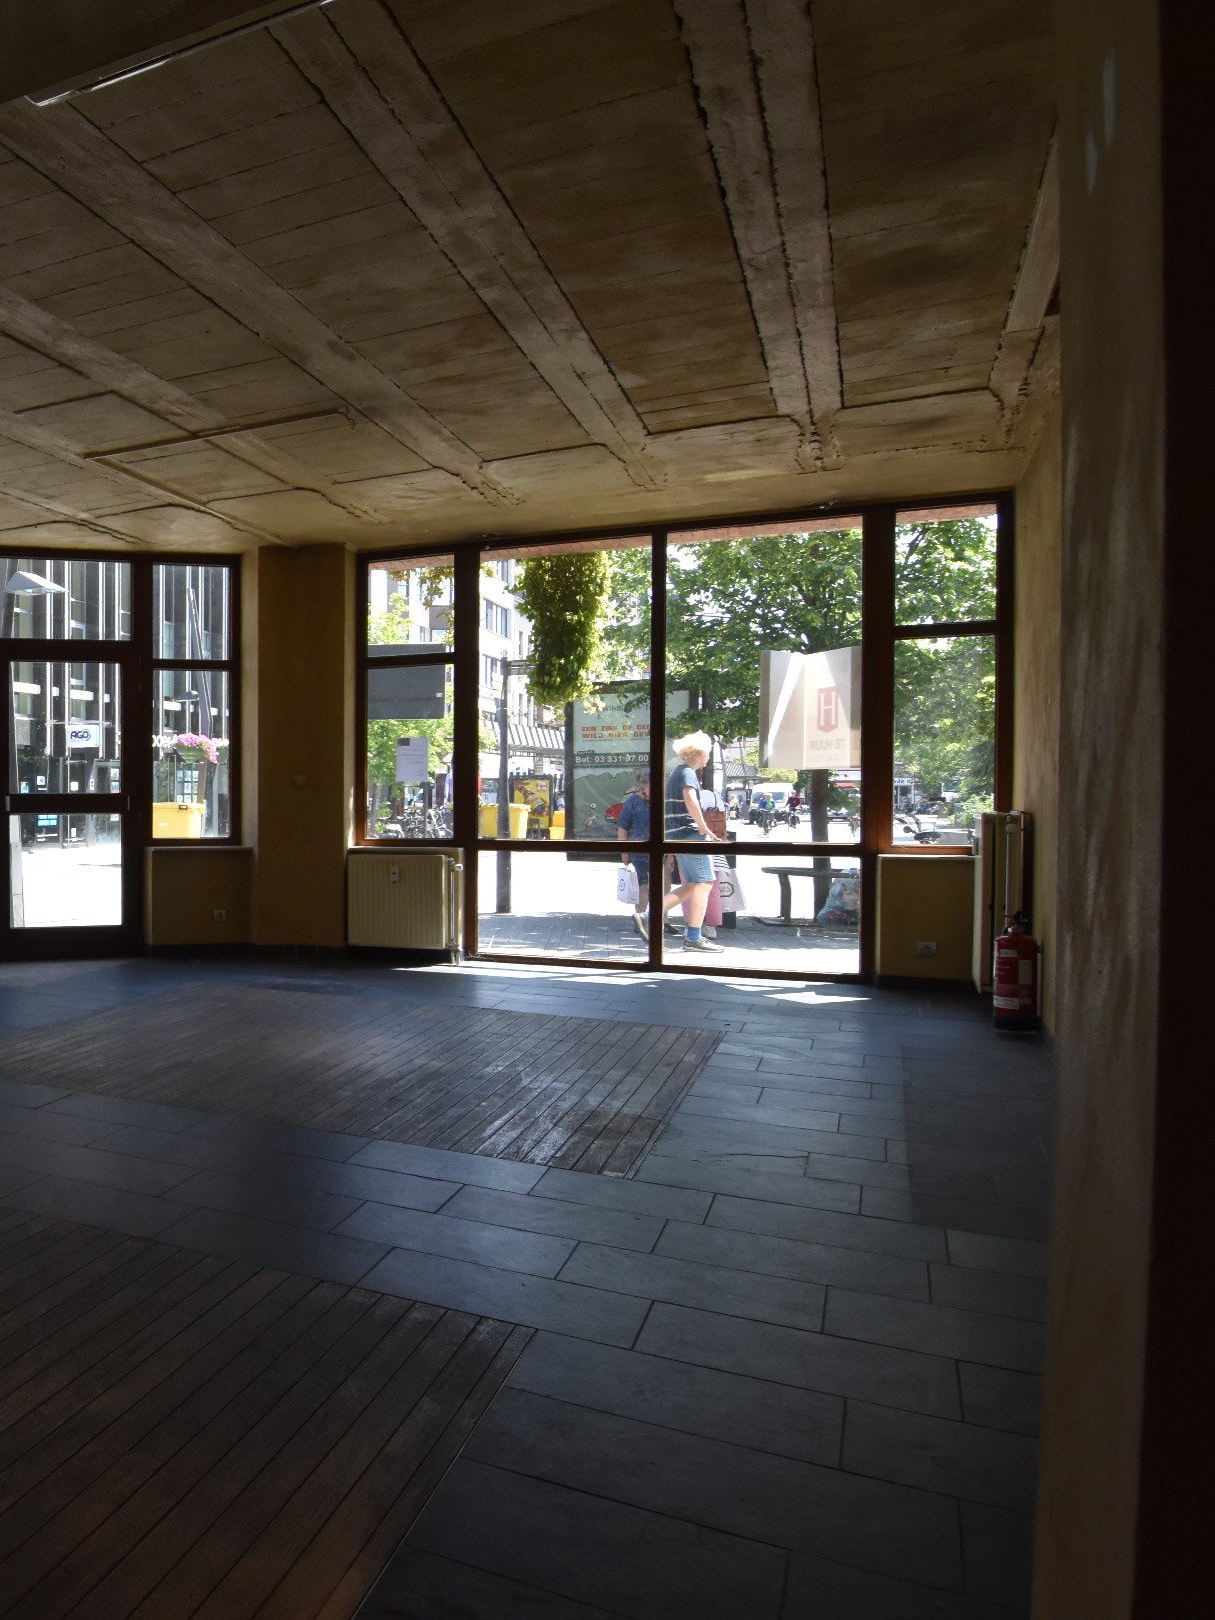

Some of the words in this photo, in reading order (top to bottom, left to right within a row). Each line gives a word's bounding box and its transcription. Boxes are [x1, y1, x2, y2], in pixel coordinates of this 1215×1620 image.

[70, 730, 90, 740] AGO
[575, 756, 591, 764] Bel:
[594, 755, 605, 763] 03
[607, 755, 622, 763] 331
[638, 754, 649, 762] 00
